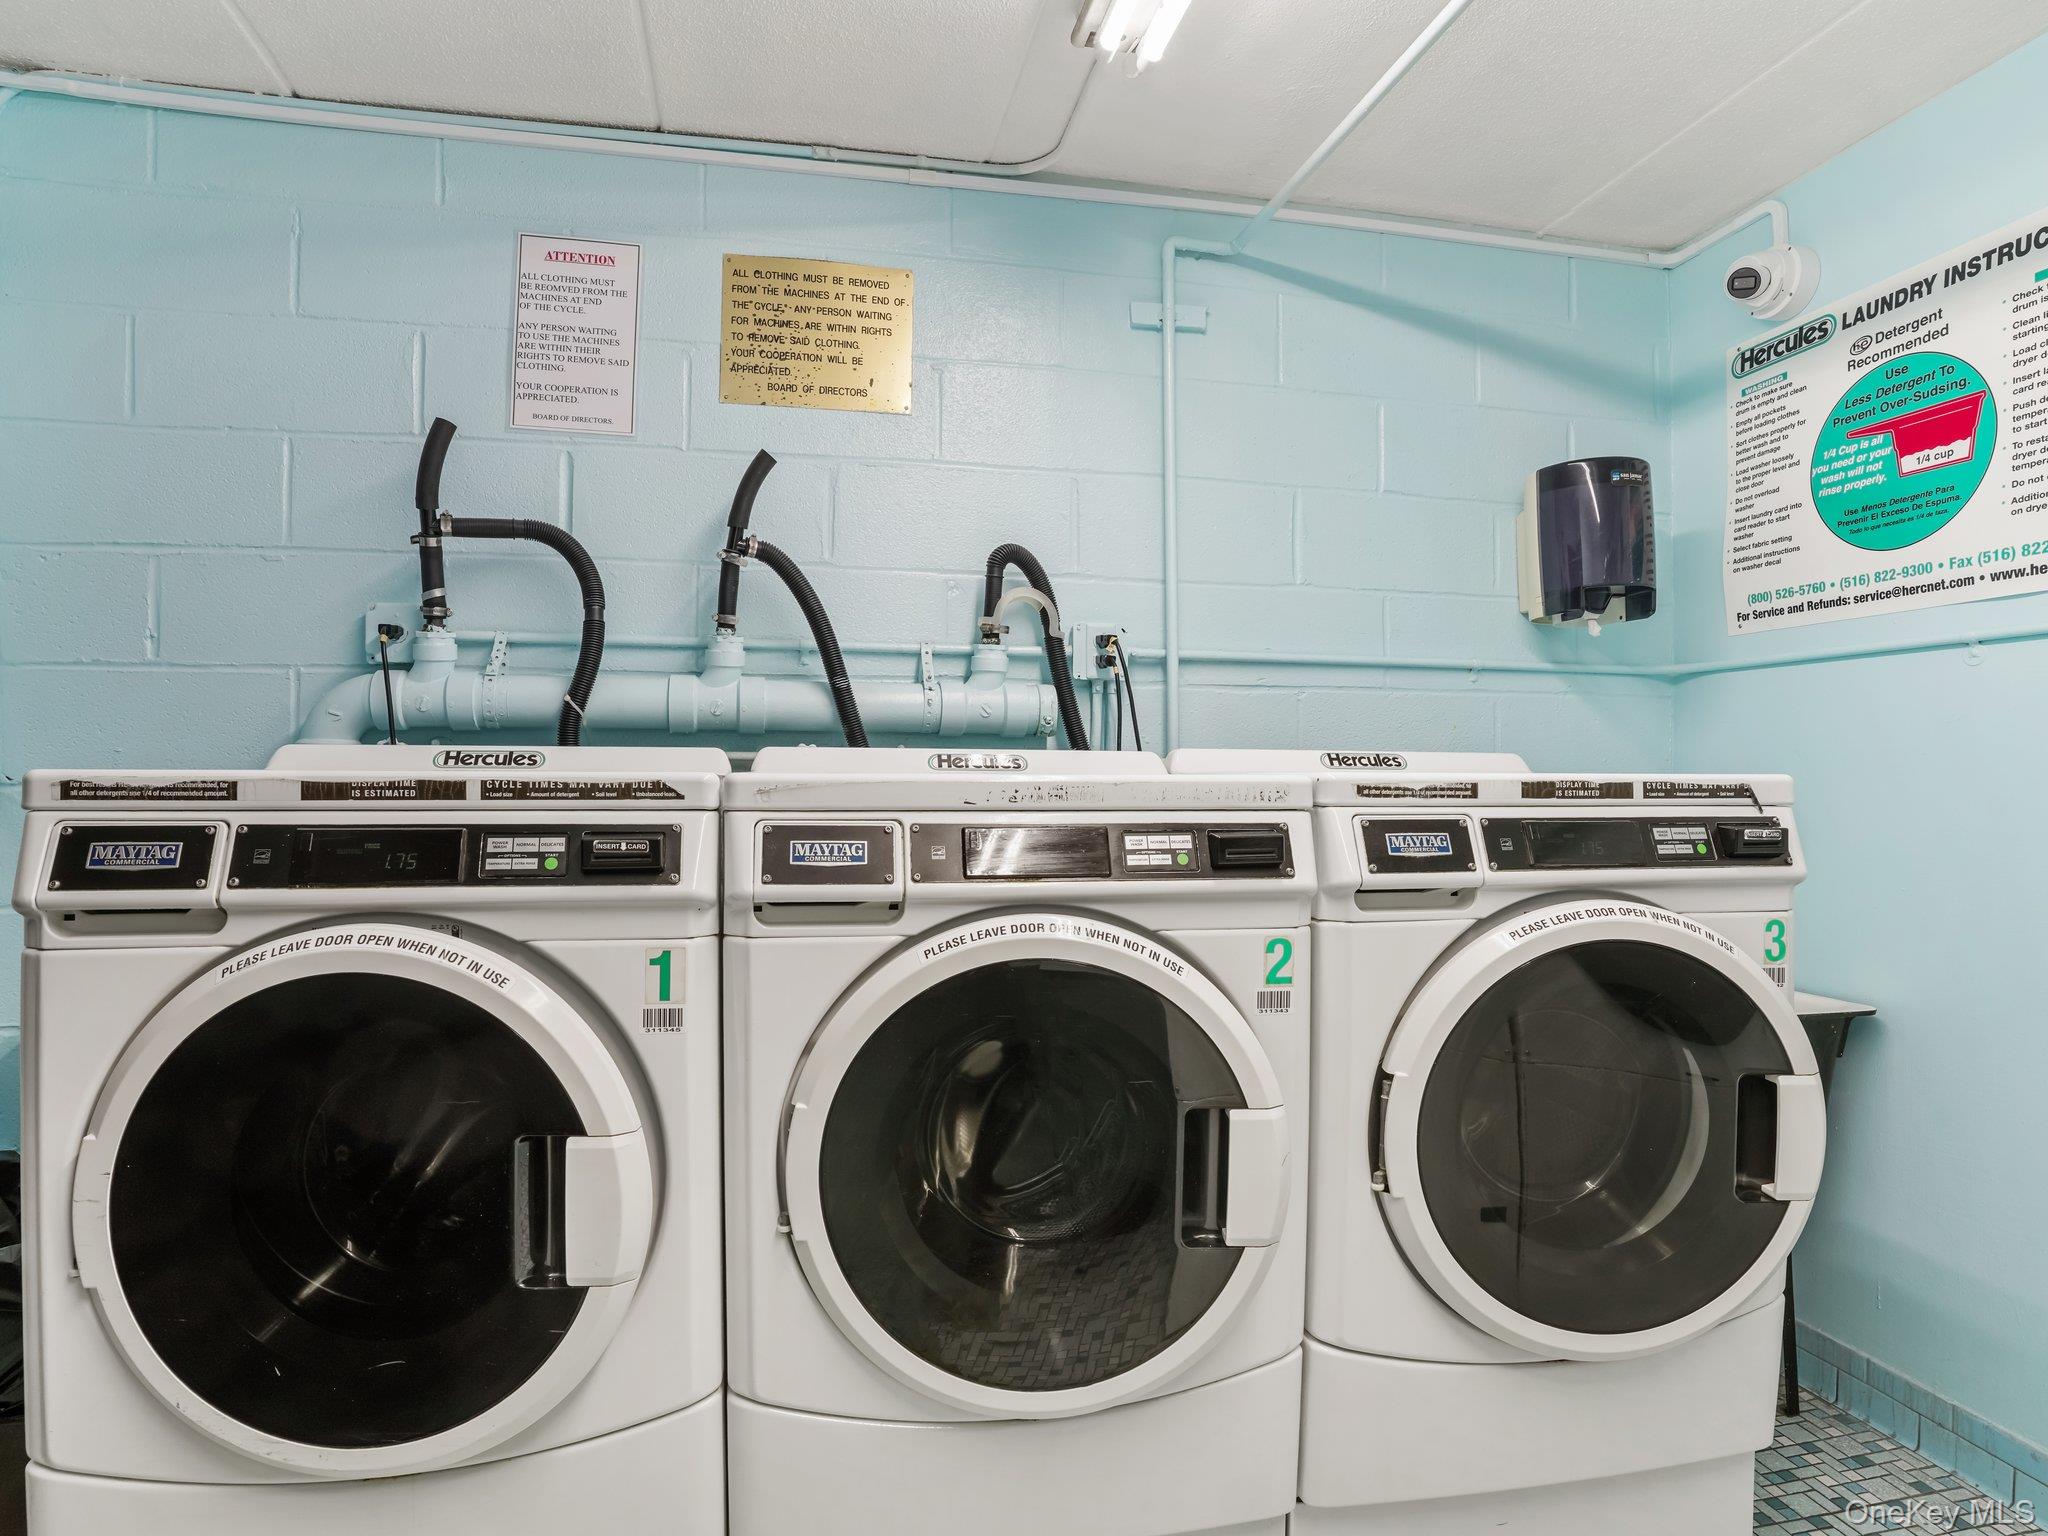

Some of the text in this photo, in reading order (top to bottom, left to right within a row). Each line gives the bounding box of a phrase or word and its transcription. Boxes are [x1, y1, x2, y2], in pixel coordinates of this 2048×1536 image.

[544, 250, 616, 267] ATTENTION
[521, 272, 615, 287] ALL CLOTHING MUST
[732, 268, 890, 290] ALL CLOTHING MUST BE REMOVED
[1841, 226, 2048, 330] LAUNDRY INSTRUC
[520, 282, 628, 298] BE REOMVED FROM THE
[731, 285, 757, 294] FROM
[762, 286, 779, 296] THE
[783, 288, 830, 300] MACHINES
[850, 294, 867, 303] THE
[871, 295, 890, 305] END
[519, 301, 586, 314] OF THE CYCLE.
[520, 292, 603, 306] MACHINES AT END
[518, 322, 617, 336] ANY PERSON WAITING
[1875, 308, 1944, 344] Detergent
[532, 333, 550, 341] USE
[552, 334, 570, 342] THE
[572, 336, 620, 346] MACHINES
[731, 332, 860, 350] TO REMOVE SAID CLOTHING.
[1740, 319, 1829, 372] Hercules
[1847, 323, 1949, 372] Recommended
[517, 342, 601, 355] ARE WITHIN THEIR
[731, 348, 863, 365] YOUR COOPERATION WILL BE
[516, 361, 566, 372] CLOTHING.
[517, 351, 630, 367] RIGHTS TO REMOVE SAID
[1885, 364, 1908, 380] Use
[515, 381, 619, 396] YOUR COOPERATION IS
[767, 383, 867, 397] BOARD OF DIRECTORS
[1845, 364, 1955, 409] Less Detergent To
[515, 393, 579, 404] APPRECIATED.
[1833, 377, 1971, 428] Prevent Over-Sudsing.
[532, 413, 559, 421] BOARD
[571, 415, 614, 425] DIRECTORS.
[1823, 435, 1883, 459] 1/4 Cup is all
[1812, 446, 1894, 477] you need or your
[1916, 449, 1954, 465] 1/4 cup
[1820, 461, 1883, 485] wash will not
[1818, 474, 1887, 498] rinse properly.
[1733, 535, 1792, 553] Select fabric setting
[1733, 545, 1800, 565] Additional instructions
[1741, 562, 1763, 572] washer
[1764, 558, 1781, 567] decal
[1747, 589, 1773, 606] (800)
[1775, 581, 1826, 600] 526-5760
[1839, 573, 1870, 591] (516)
[1874, 562, 1933, 585] 822-9300
[1948, 557, 1973, 570] Fax
[1977, 546, 2016, 566] (516)
[1737, 611, 1750, 622] For
[1752, 605, 1785, 620] Service
[1787, 601, 1804, 614] and
[1807, 596, 1851, 612] Refunds:
[1853, 574, 1975, 605] service@hercnet.com
[443, 751, 538, 766] Hercules
[1327, 753, 1402, 767] Hercules
[794, 843, 863, 857] MAYTAG
[1390, 835, 1448, 849] MAYTAG
[92, 845, 177, 860] MAYTAG
[1509, 907, 1735, 955] PLEASE LEAVE DOOR OPEN WHEN NOT IN USE
[1764, 919, 1787, 962] 3
[221, 934, 510, 989] PLEASE LEAVE DOOR OPEN WHEN NOT IN USE
[1265, 938, 1292, 984] 2
[649, 950, 671, 1001] 1
